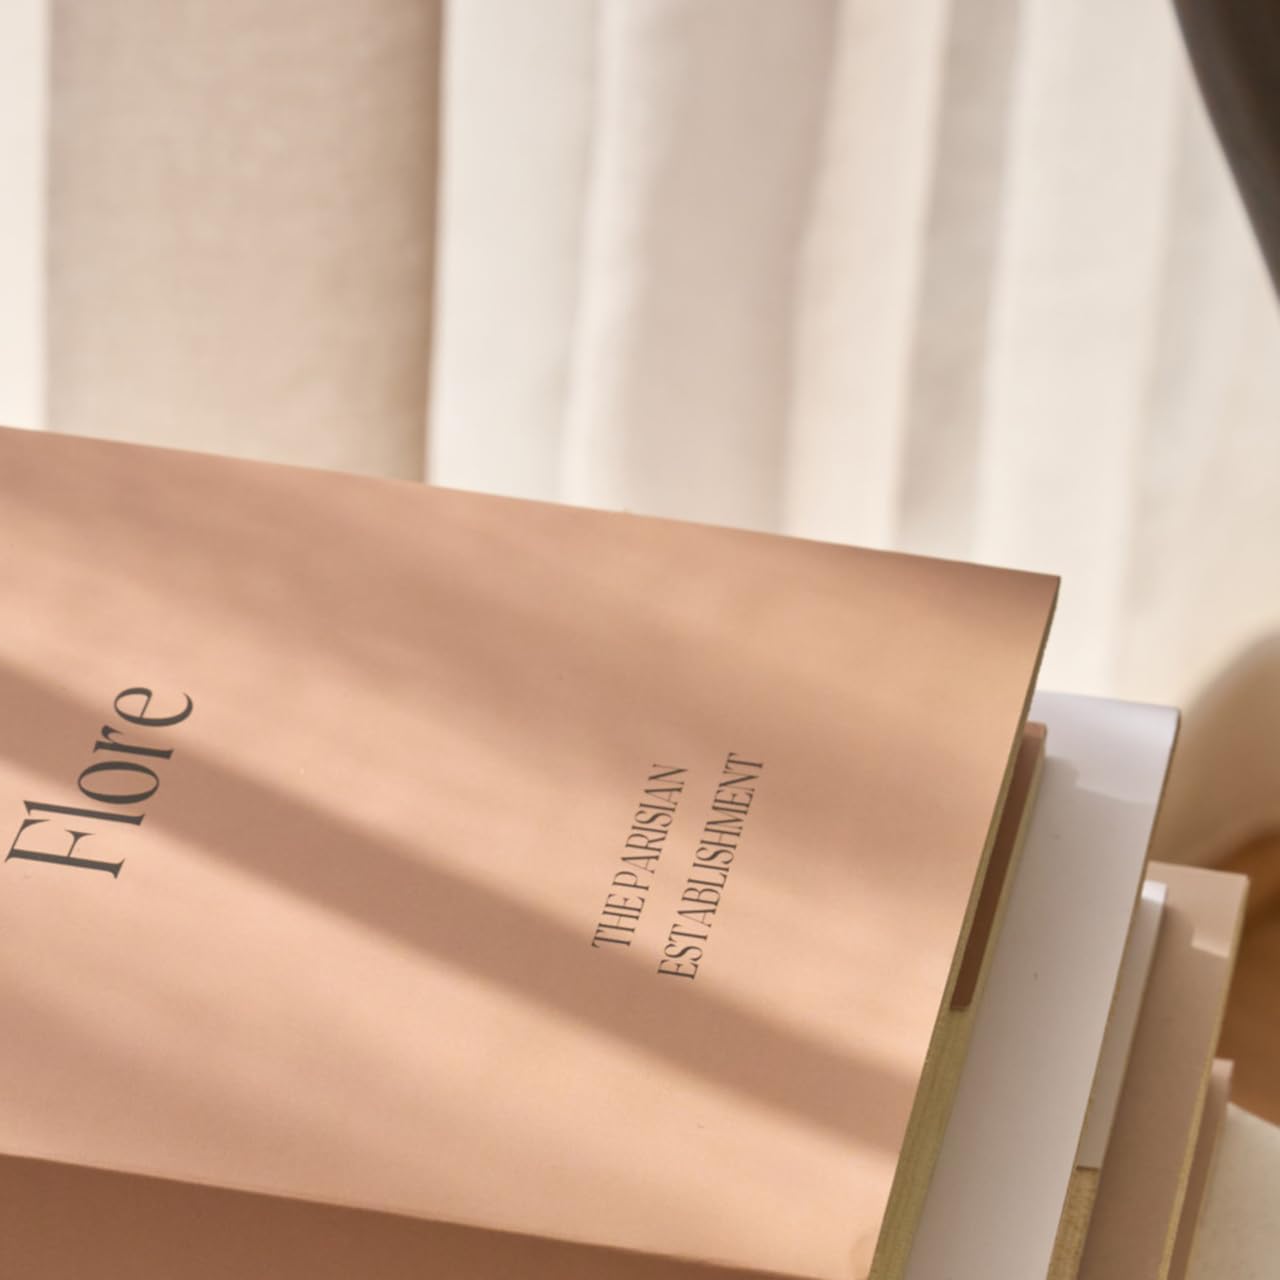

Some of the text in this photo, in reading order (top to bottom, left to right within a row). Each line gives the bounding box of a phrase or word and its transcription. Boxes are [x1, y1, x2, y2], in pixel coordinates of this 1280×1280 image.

[5, 687, 193, 879] Flore
[591, 764, 688, 949] THE PARISIAN
[657, 752, 764, 980] ESTABLISHMENT
